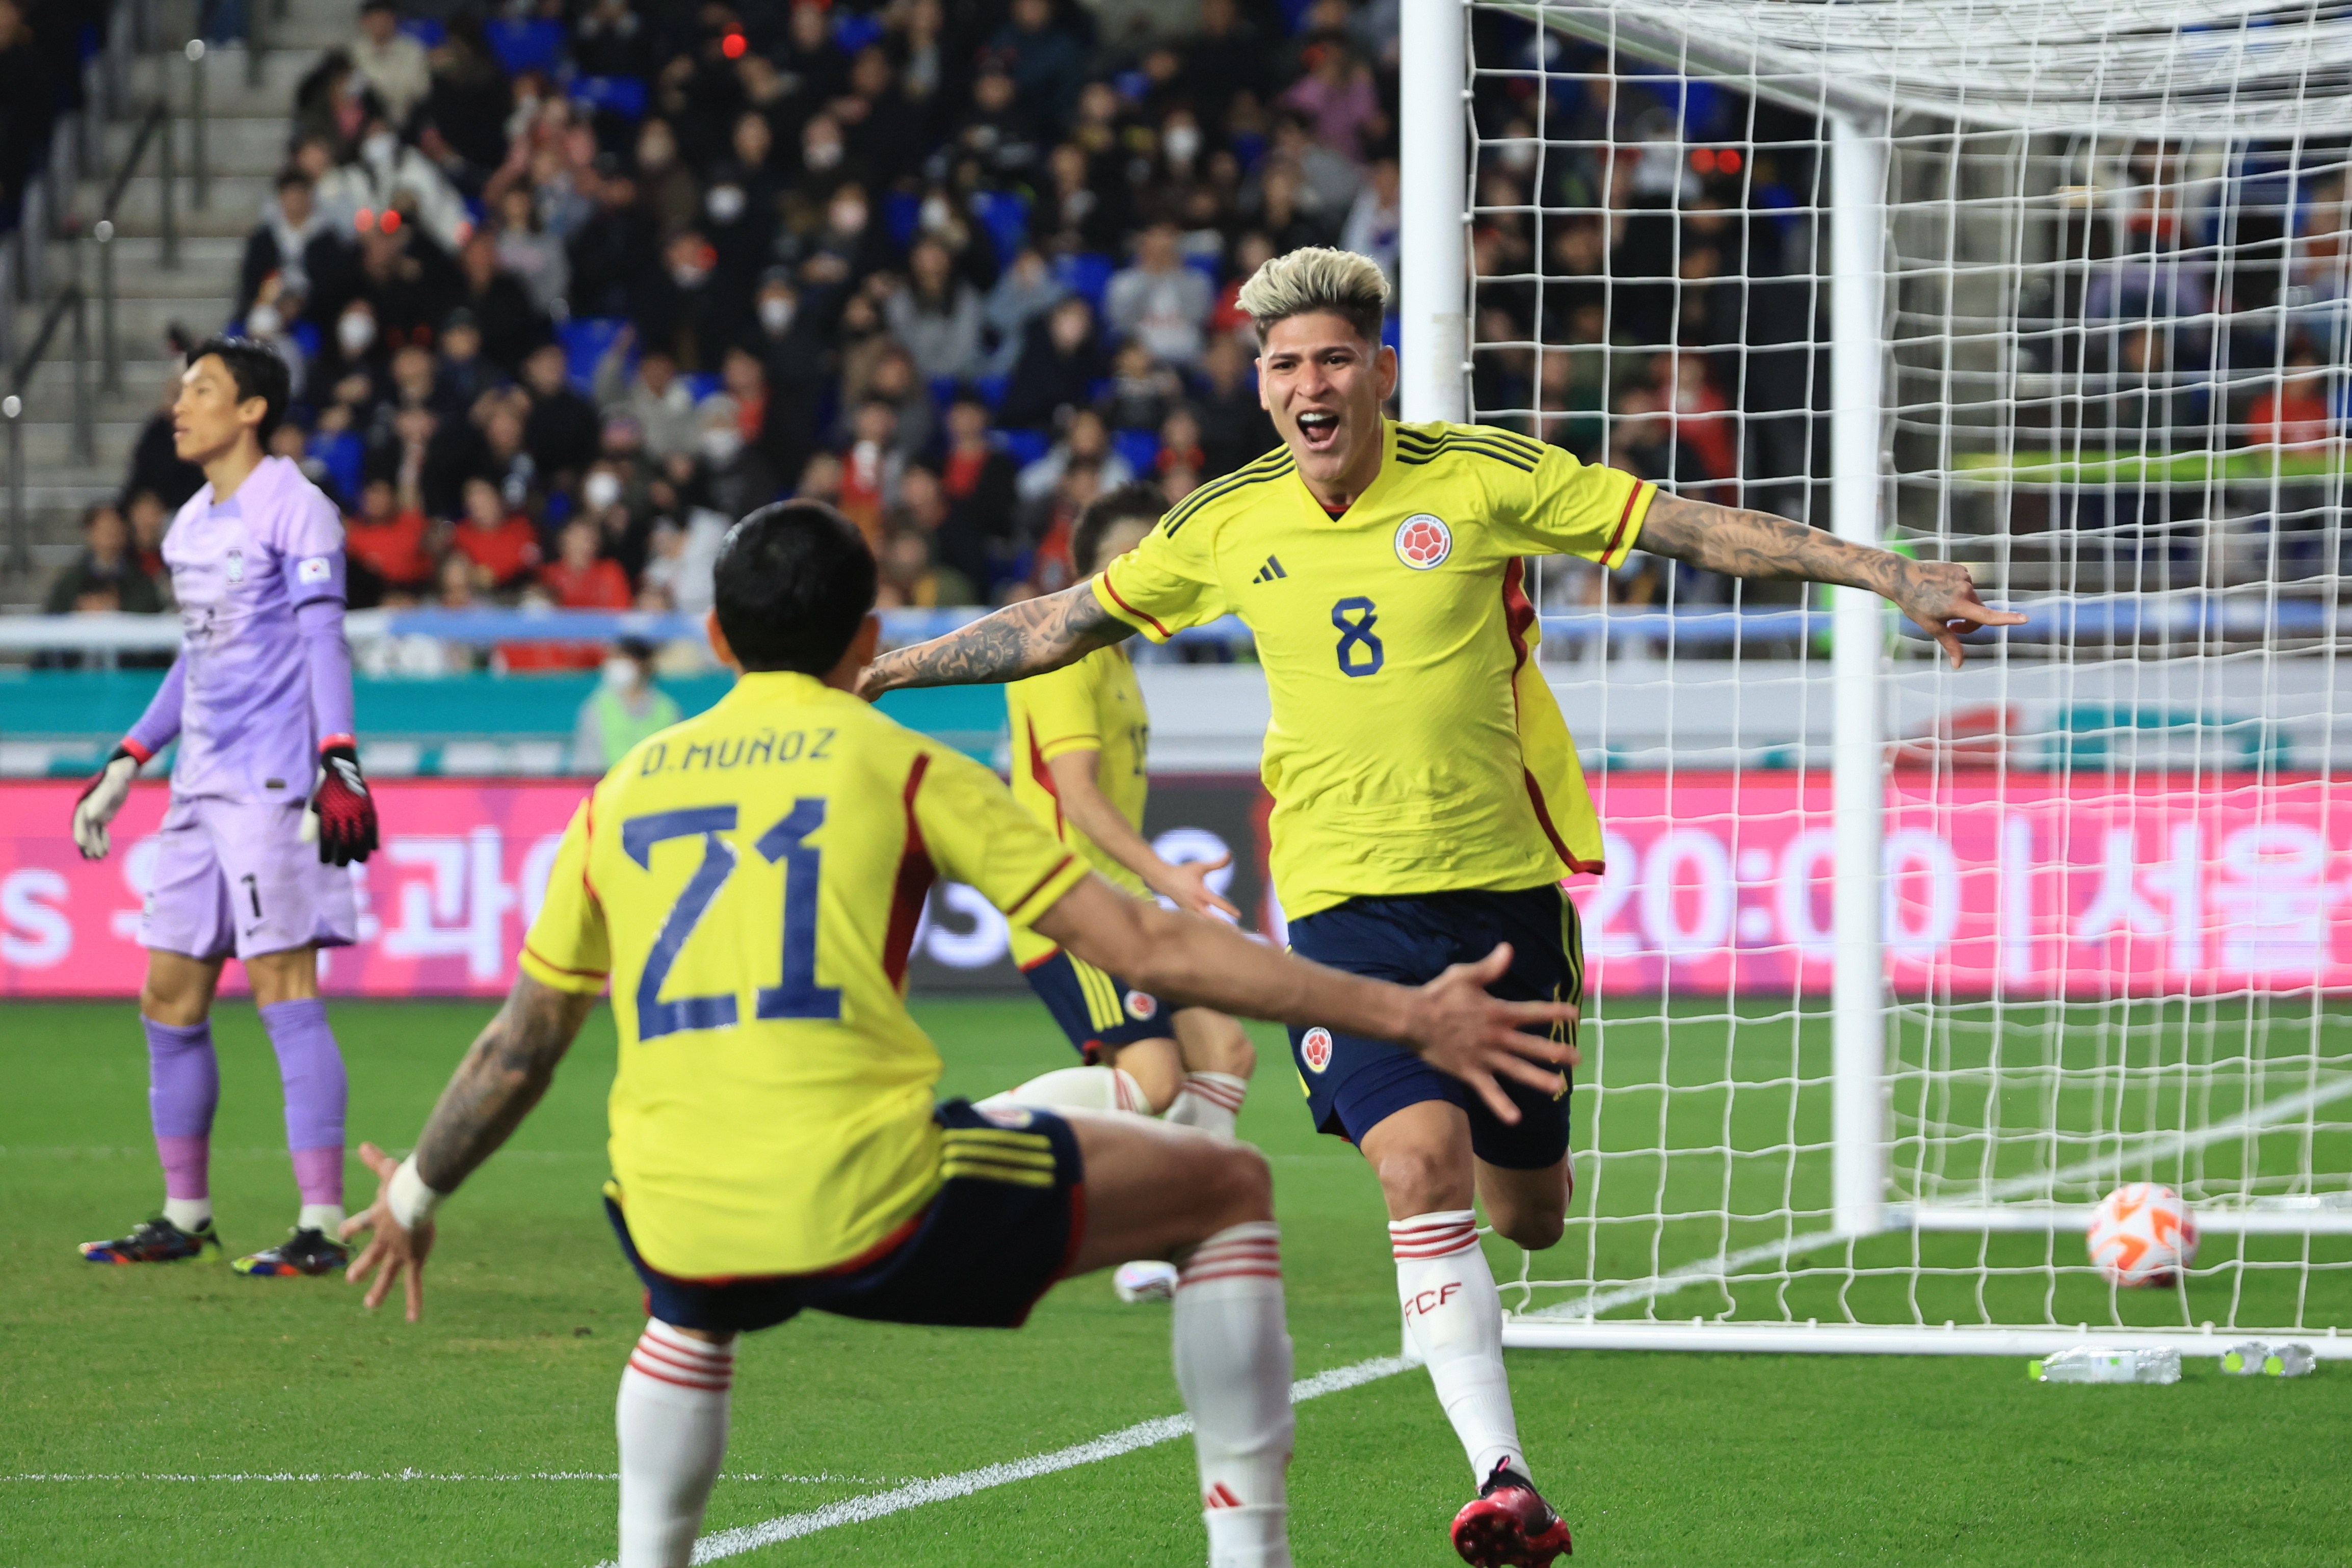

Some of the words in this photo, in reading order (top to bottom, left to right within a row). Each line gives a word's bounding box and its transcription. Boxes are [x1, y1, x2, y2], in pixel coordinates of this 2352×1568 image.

[1332, 596, 1384, 677] 8
[641, 727, 836, 777] D.MUÑOZ
[241, 872, 261, 918] 1
[621, 796, 842, 1043] 21
[1580, 827, 1959, 962] 20:00
[1405, 1282, 1462, 1327] FCF
